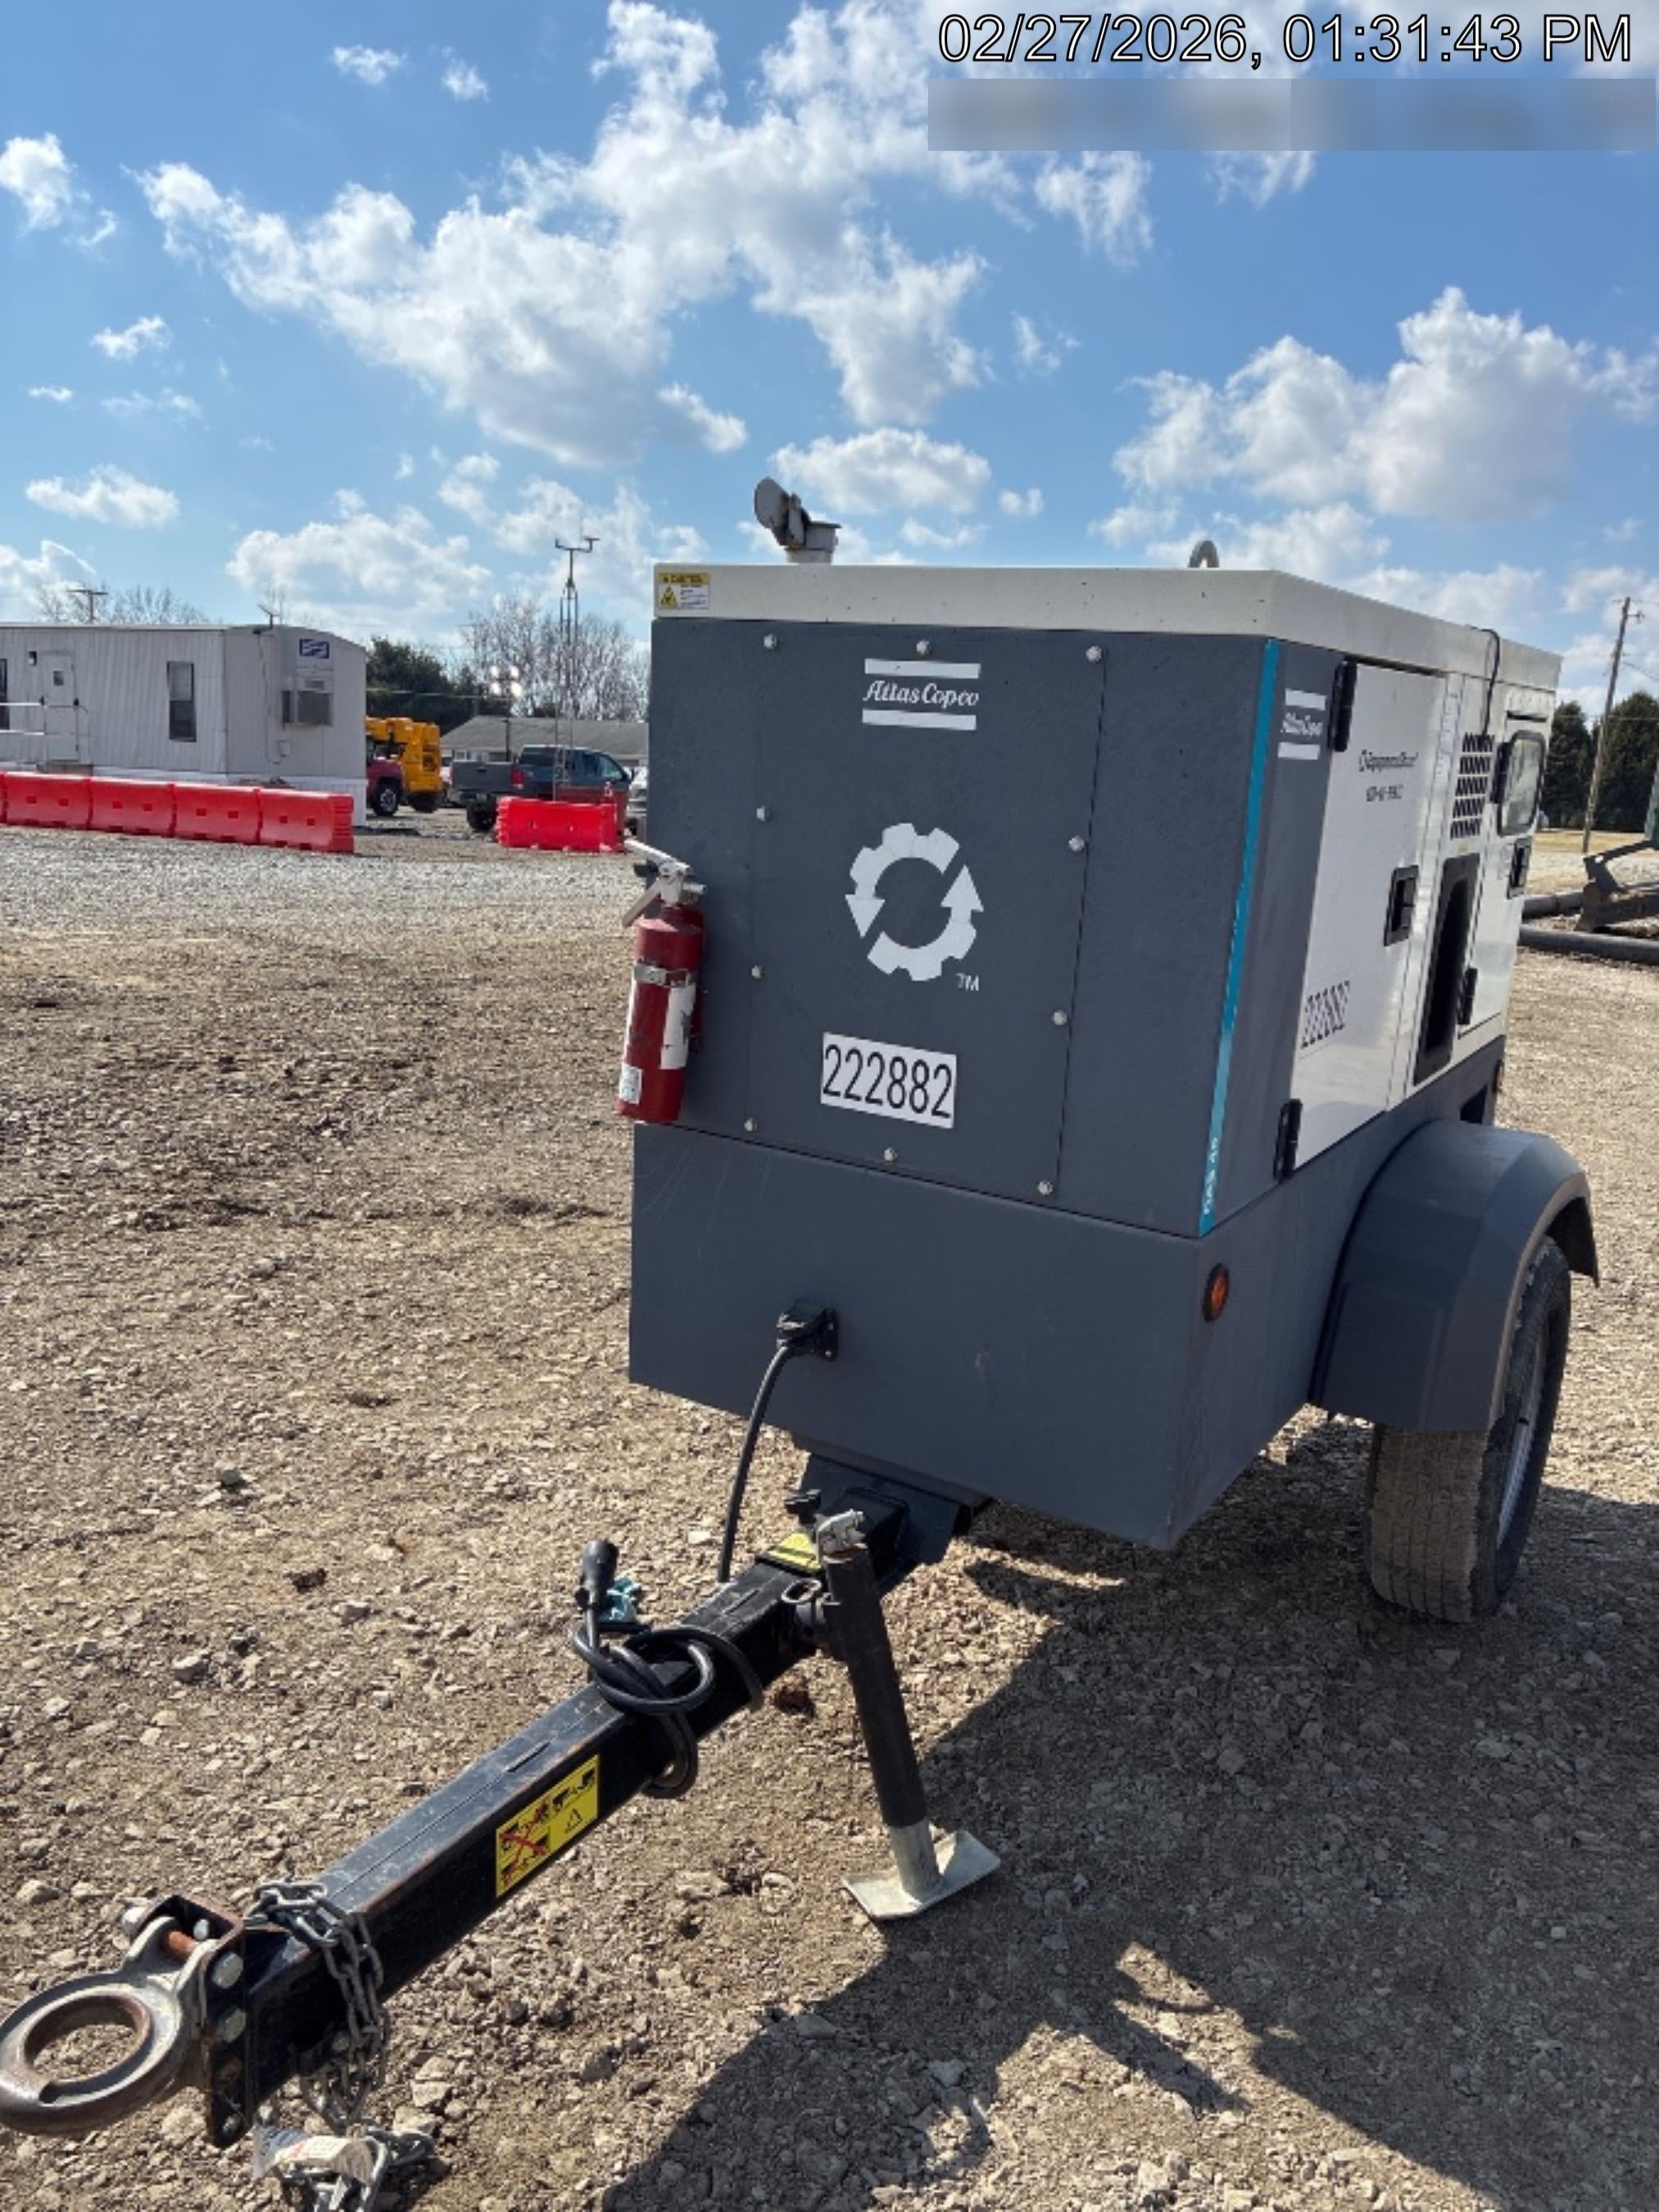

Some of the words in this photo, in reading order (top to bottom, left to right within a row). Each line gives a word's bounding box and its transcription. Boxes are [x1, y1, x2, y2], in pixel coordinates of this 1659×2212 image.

[862, 680, 920, 704] Atlas
[921, 682, 979, 709] Copco
[955, 972, 979, 991] TM
[823, 1044, 952, 1118] 222882
